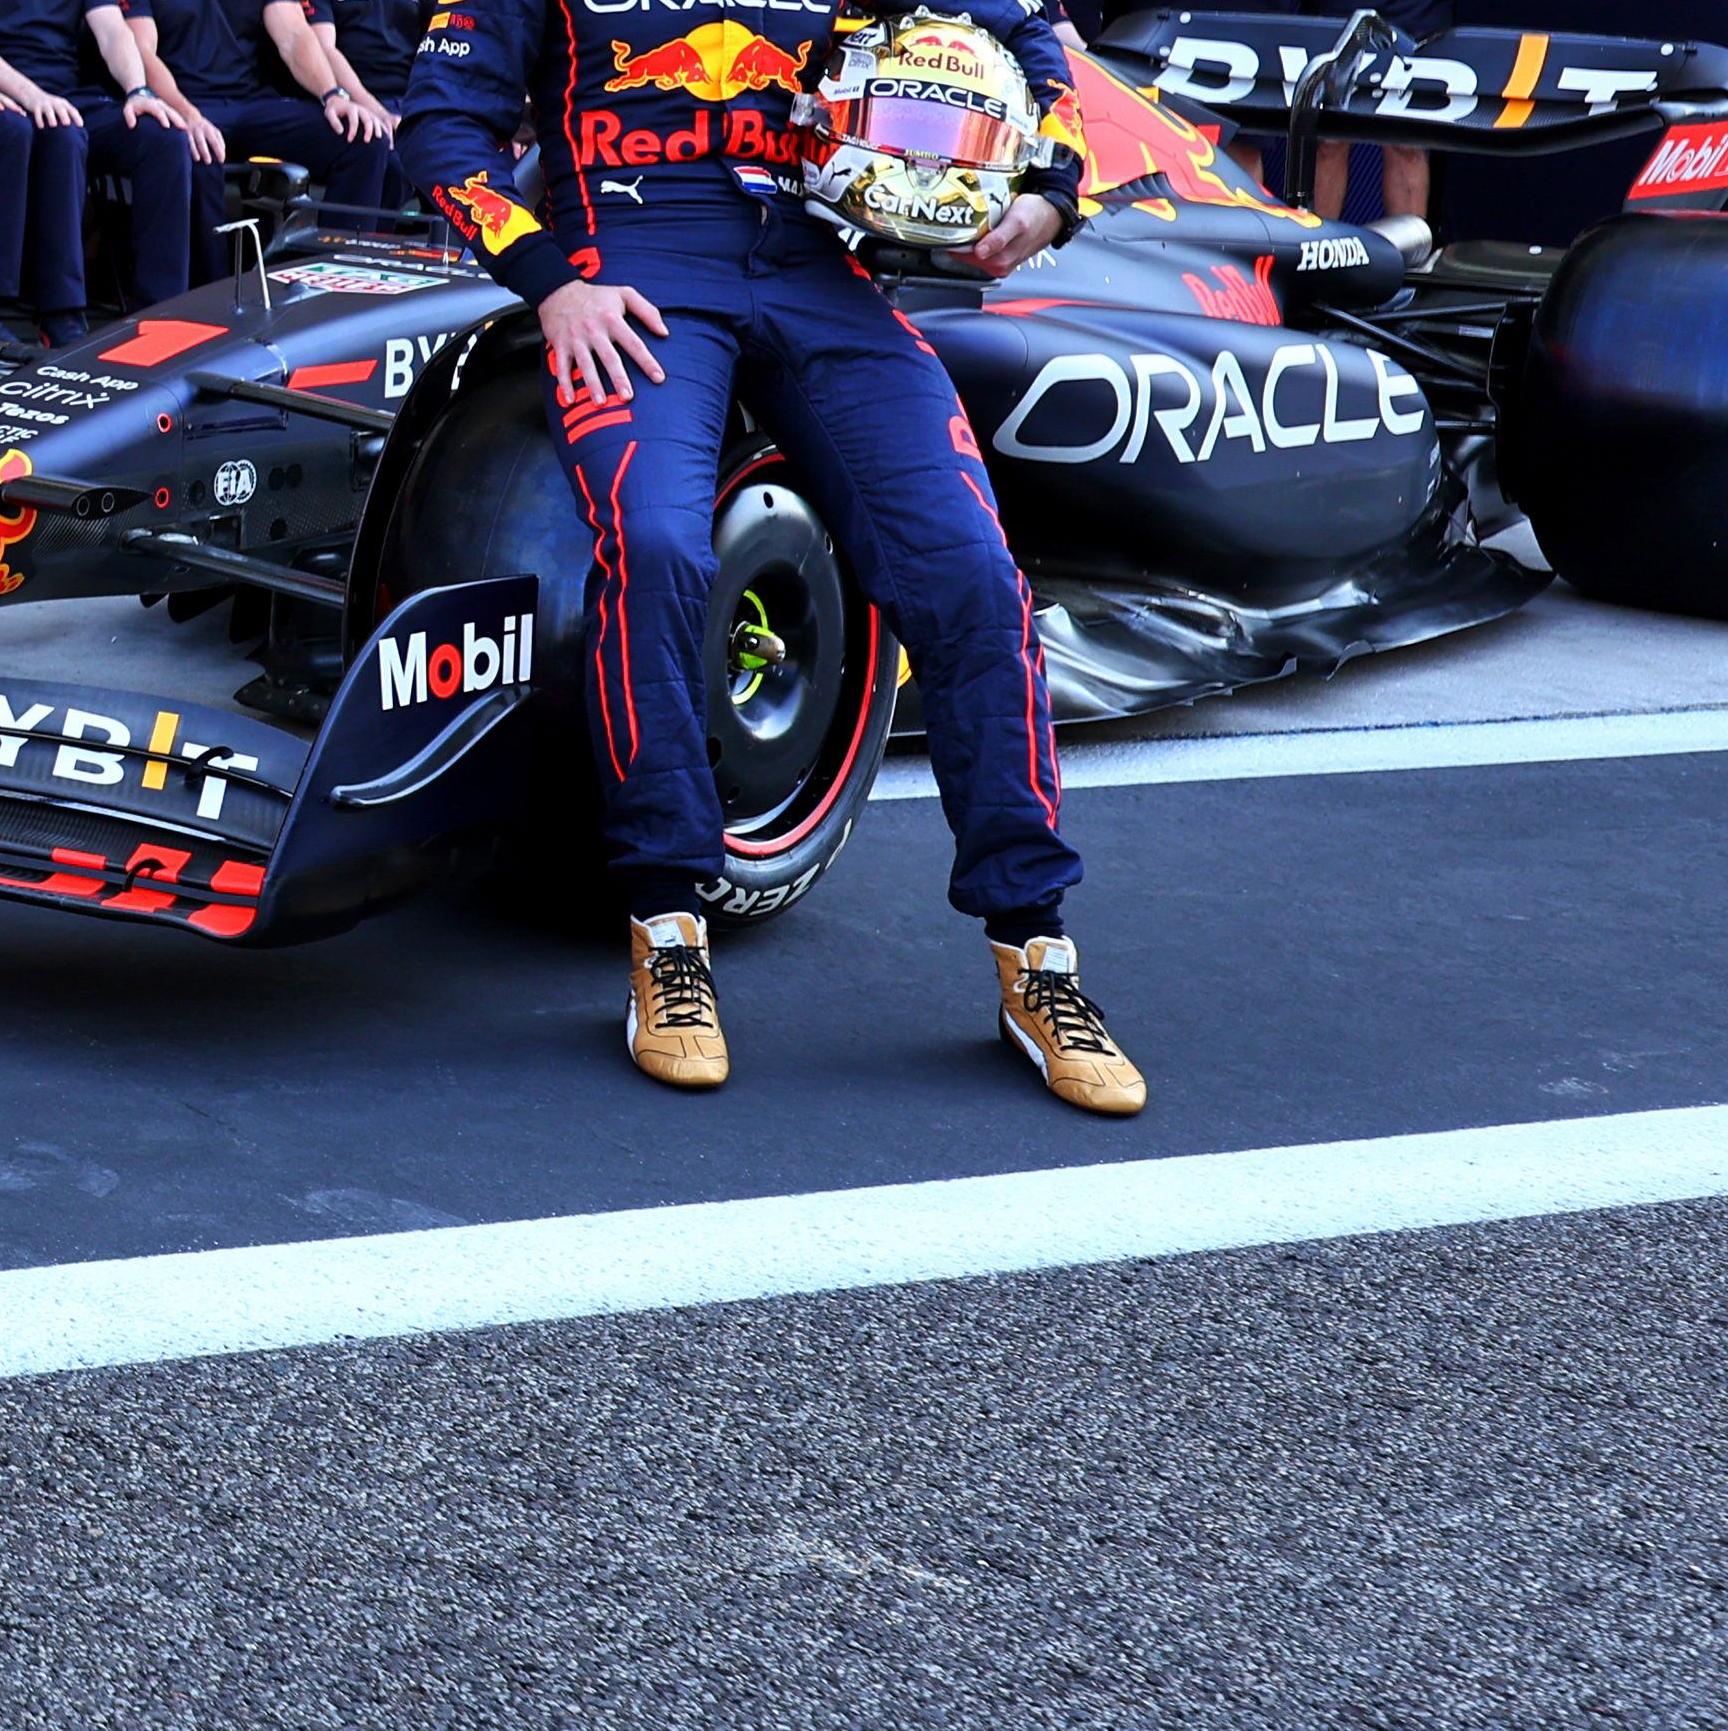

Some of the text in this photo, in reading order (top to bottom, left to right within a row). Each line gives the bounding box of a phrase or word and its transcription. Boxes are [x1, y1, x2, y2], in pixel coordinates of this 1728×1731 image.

[438, 37, 471, 58] App
[898, 50, 985, 80] Red Bull
[869, 79, 1006, 120] ORACLE
[581, 110, 709, 166] Red
[1642, 138, 1715, 187] Mobil
[432, 185, 478, 241] Red Bull
[863, 185, 974, 224] CarNext
[1297, 236, 1370, 271] HONDA
[98, 319, 229, 367] 1
[36, 365, 140, 391] Cash App
[992, 343, 1426, 463] ORACLE
[217, 470, 254, 495] FIA
[378, 613, 534, 711] Mobil
